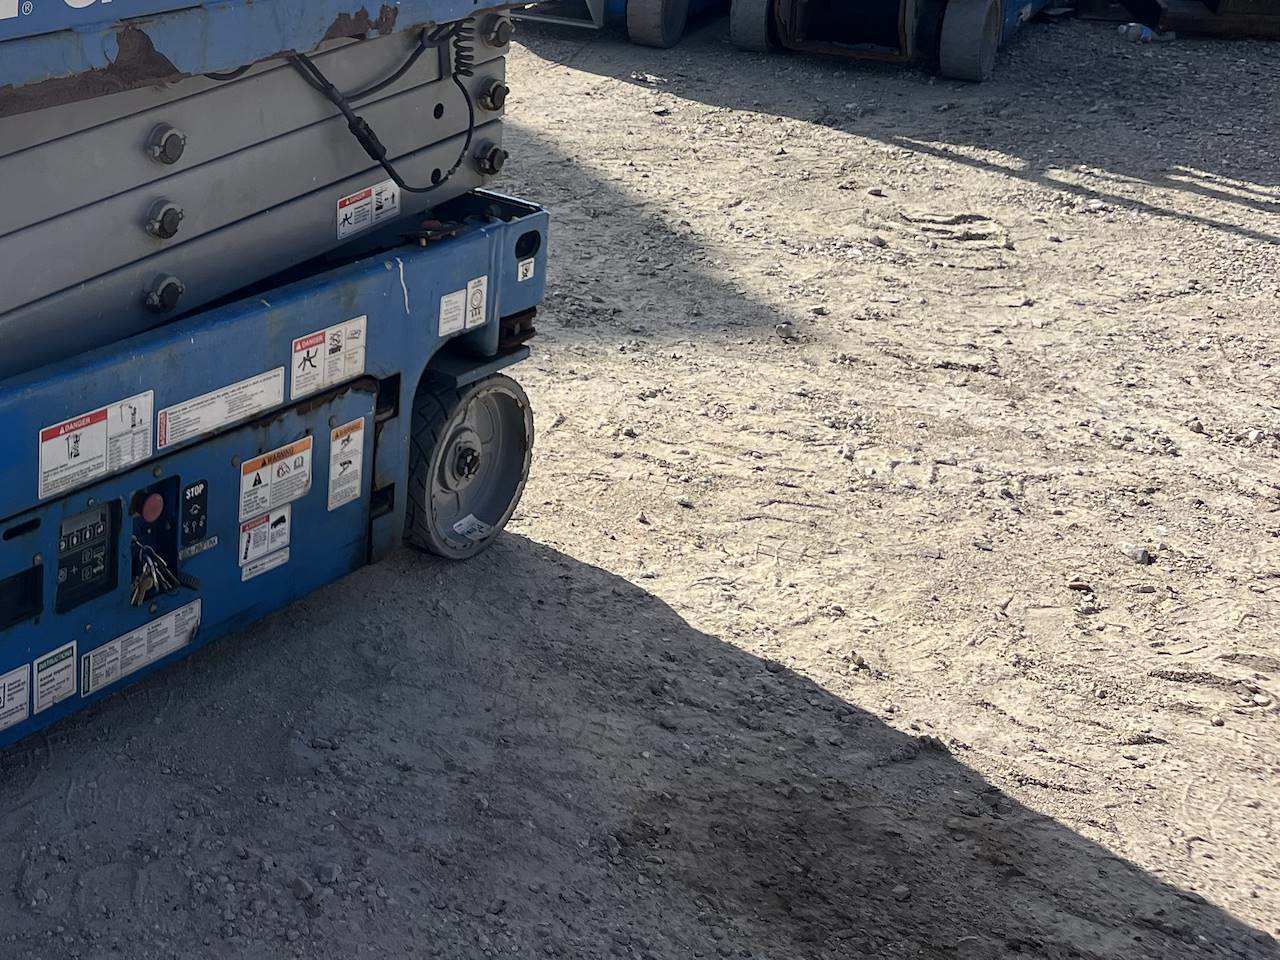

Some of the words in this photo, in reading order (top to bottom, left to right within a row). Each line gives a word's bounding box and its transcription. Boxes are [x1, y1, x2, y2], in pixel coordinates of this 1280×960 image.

[64, 416, 91, 433] DANGER
[267, 445, 295, 465] WARNING
[186, 483, 204, 500] STOP
